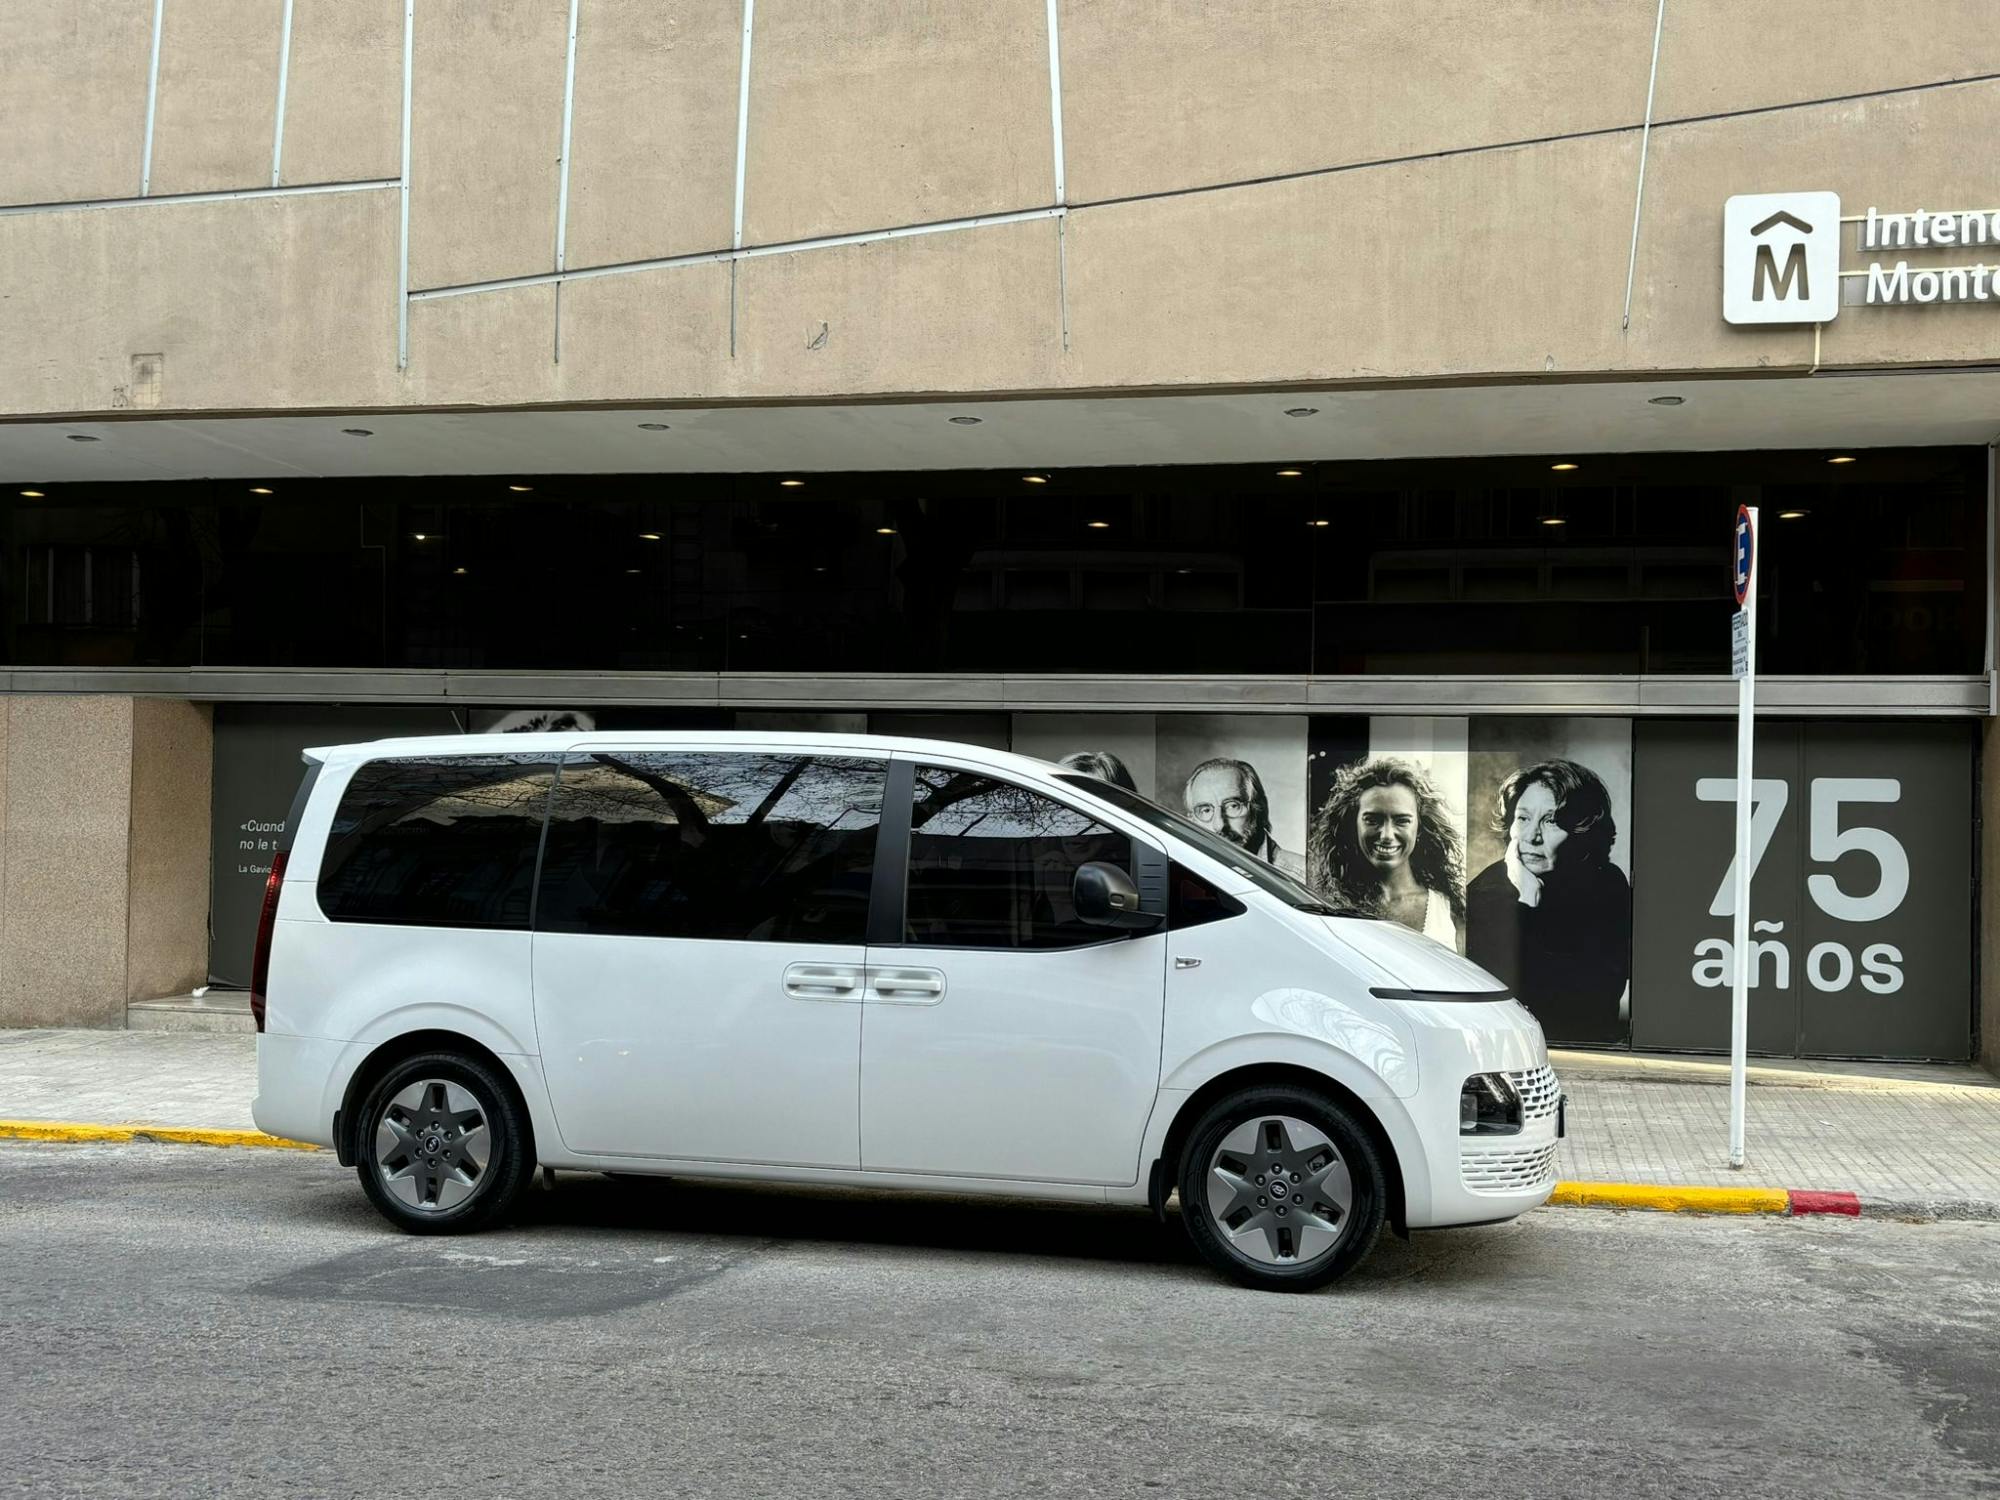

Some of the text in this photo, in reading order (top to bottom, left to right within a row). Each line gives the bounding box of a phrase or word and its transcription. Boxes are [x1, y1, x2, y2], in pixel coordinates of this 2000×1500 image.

[1752, 243, 1810, 301] M
[238, 864, 248, 873] La
[240, 840, 254, 850] no
[257, 838, 268, 850] le
[1696, 777, 1910, 922] 75
[1692, 920, 1904, 994] años
